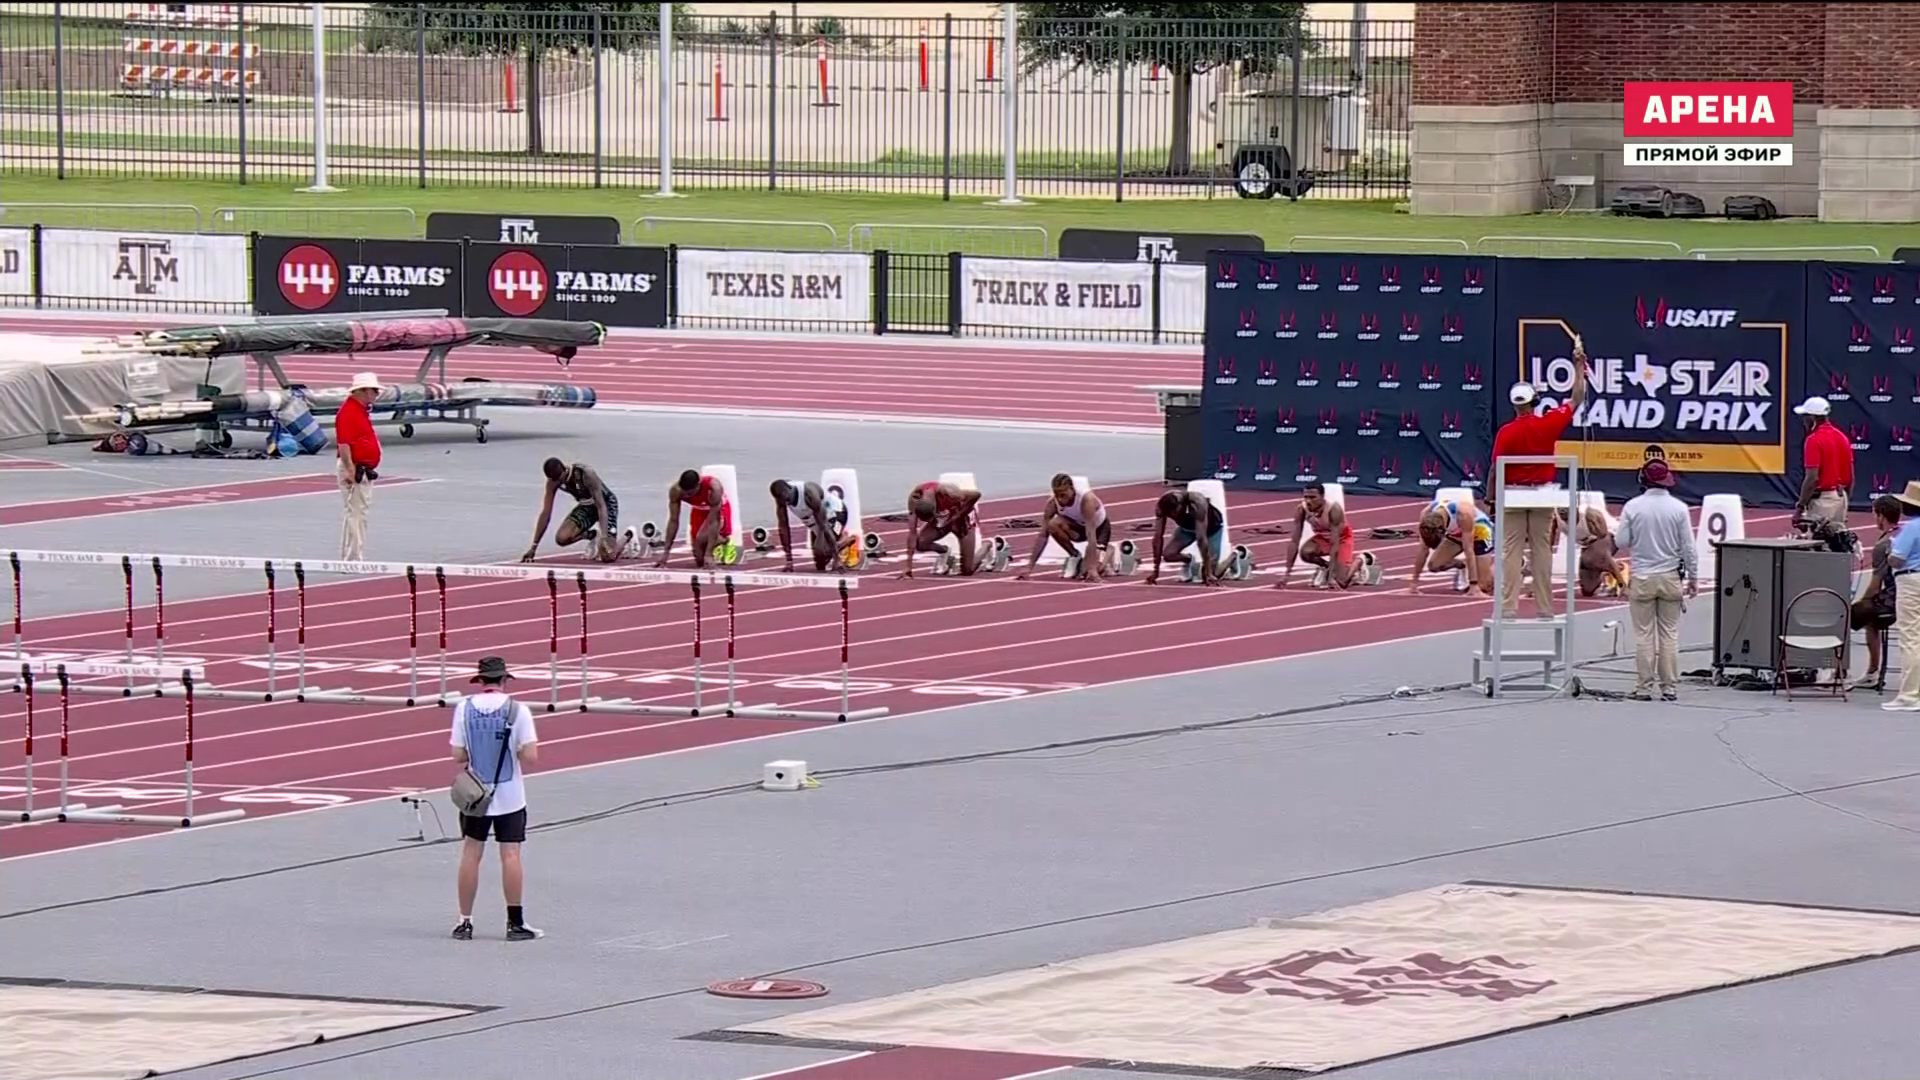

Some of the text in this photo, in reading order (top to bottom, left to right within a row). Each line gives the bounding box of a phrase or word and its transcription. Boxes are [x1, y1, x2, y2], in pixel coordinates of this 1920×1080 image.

[284, 263, 334, 294] 44
[493, 269, 544, 301] 44
[706, 271, 842, 300] TEXAS A&M
[347, 287, 411, 298] SINCE 1909
[555, 293, 588, 303] SINCE
[972, 278, 1142, 309] TRACK & FIELD
[1665, 308, 1737, 328] USATF
[1532, 357, 1772, 397] LONE STAR
[1676, 401, 1772, 431] PRIX
[1708, 512, 1727, 548] 9
[773, 680, 893, 691] 8
[911, 685, 1029, 697] 9
[67, 786, 202, 799] 8
[219, 792, 352, 805] 9
